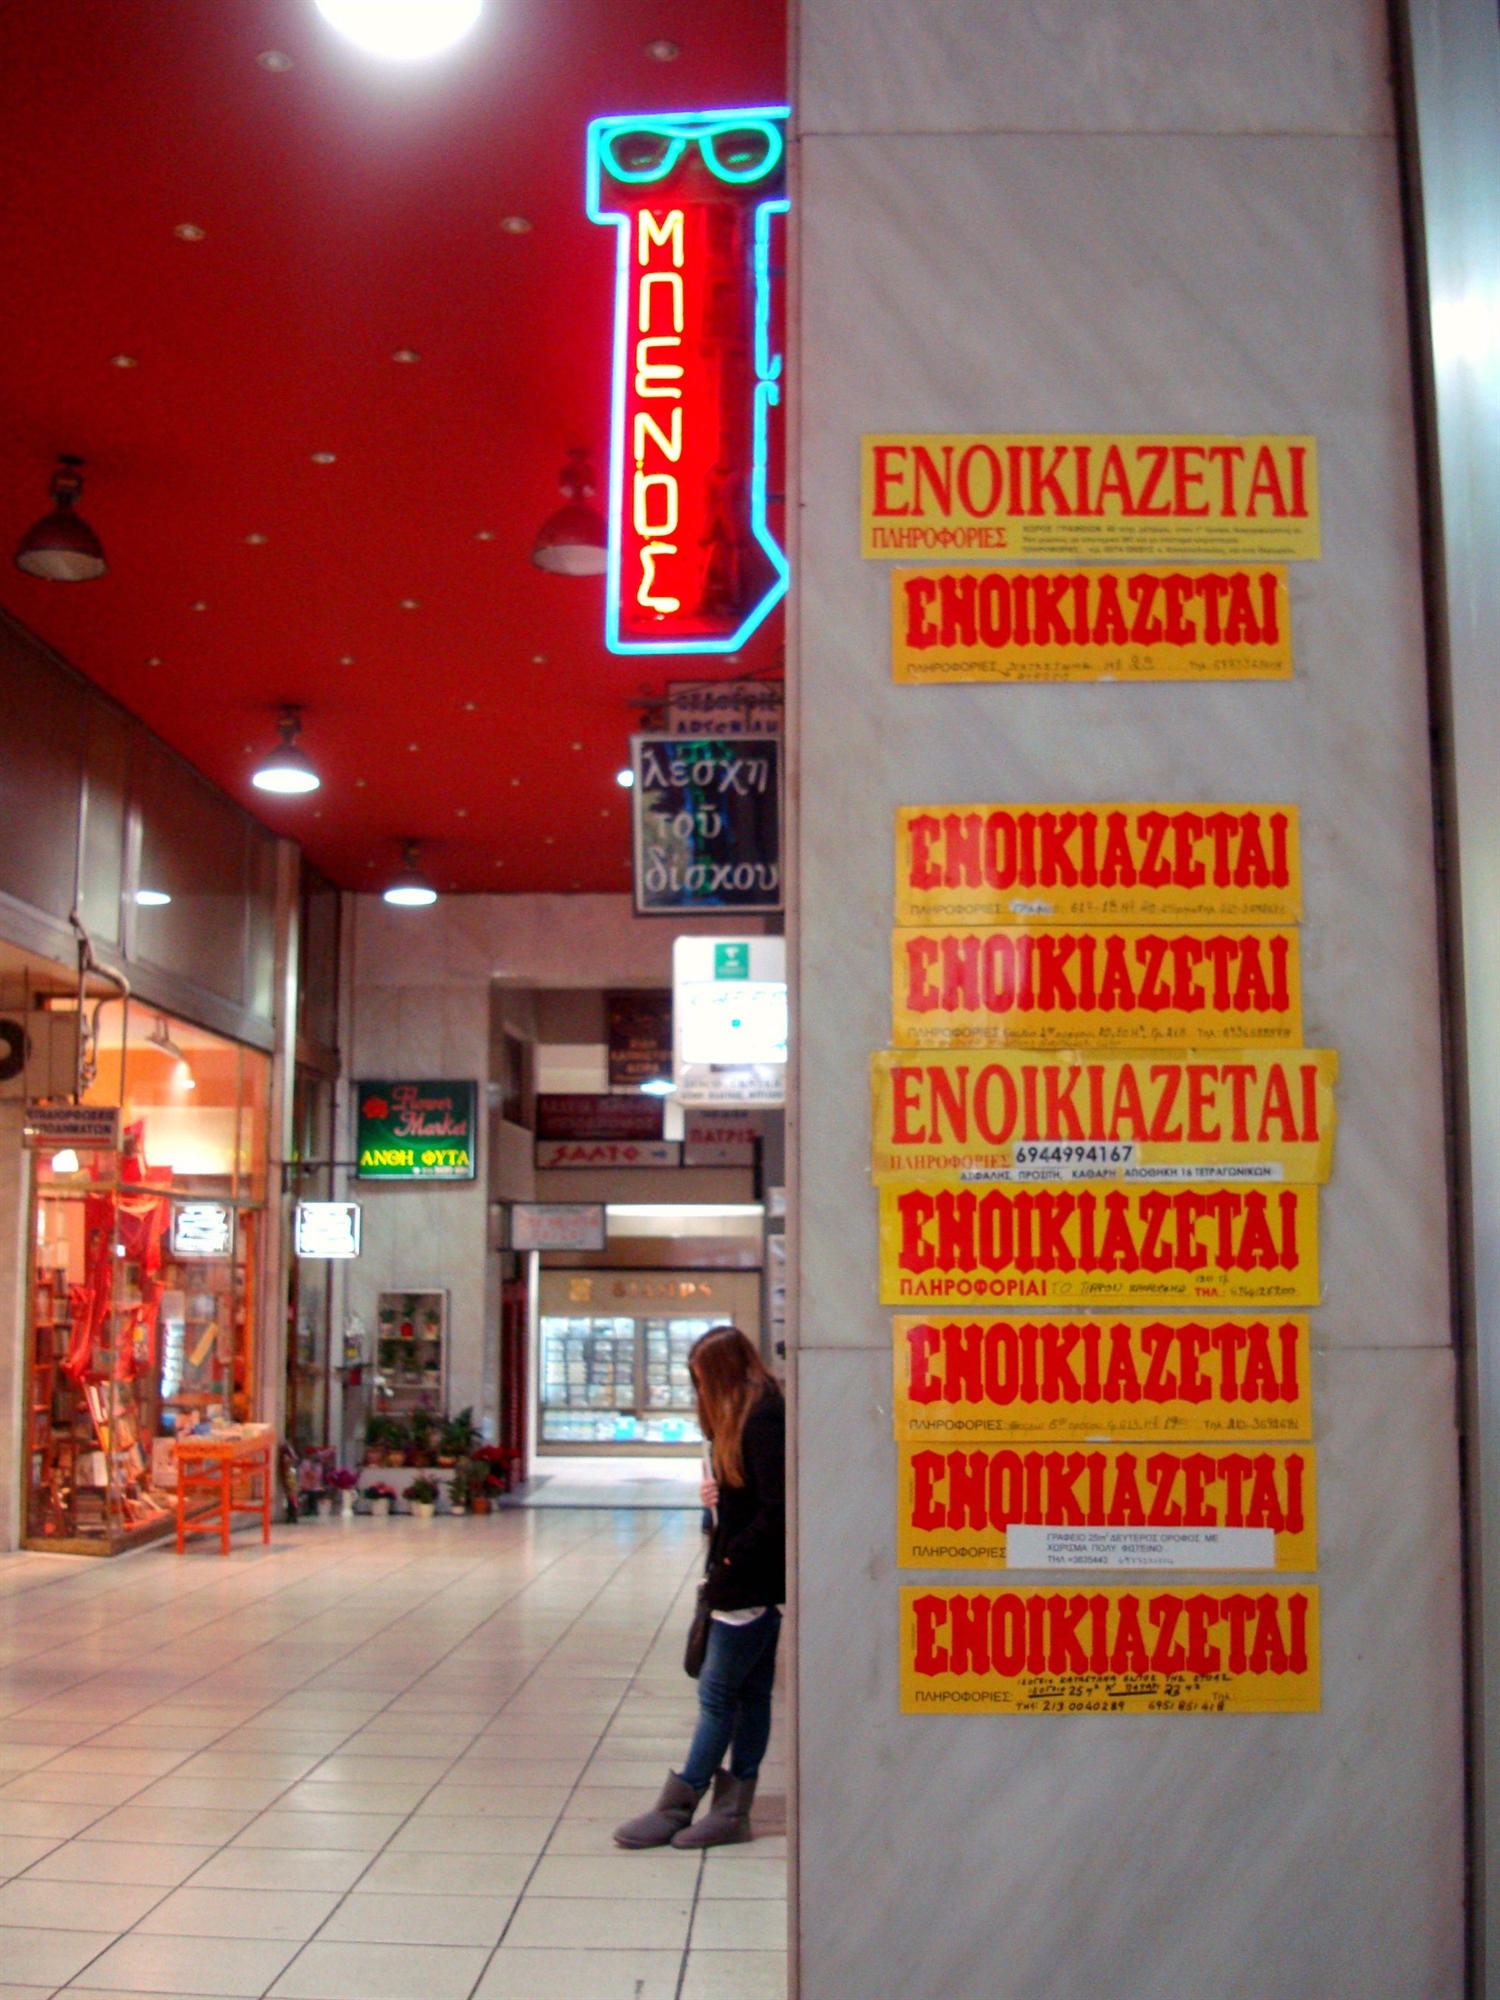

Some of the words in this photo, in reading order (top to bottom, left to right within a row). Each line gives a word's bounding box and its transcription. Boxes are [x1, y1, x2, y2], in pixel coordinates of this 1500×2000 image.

[872, 444, 1308, 518] ΕΝΟΙΚΙΑΖΕΤΑΙ
[872, 527, 1007, 549] ΠΛΗΡΟΦΟΡΙΕΣ
[904, 572, 1279, 649] ΕΝΟΙΚΙΑΖΕΤΑΙ
[907, 811, 1289, 891] ΕΝΟΙΚΙΑΖΕΤΑΙ
[906, 934, 1289, 1013] ΕΝΟΙΚΙΑΖΕΤΑΙ
[393, 1111, 467, 1137] Market
[890, 1063, 1319, 1145] ΕΝΟΙΚΙΑΖΕΤΑΙ
[361, 1149, 414, 1166] ΑΝΘΗ
[421, 1149, 469, 1166] ΦΥΤΑ
[890, 1154, 1011, 1170] ΠΛΗΡΟΦΟΡΙΕΣ
[1015, 1145, 1133, 1164] 6944994167
[1123, 1168, 1178, 1178] ΑΠΟΘΗΚΗ
[898, 1188, 1298, 1274] ΕΝΟΙΚΙΑΖΕΤΑΙ
[900, 1278, 1047, 1297] ΠΛΗΡΟΦΟΡΙΑΙ
[907, 1322, 1299, 1405] ΕΝΟΙΚΙΑΖΕΤΑΙ
[911, 1450, 1304, 1535] ΕΝΟΙΚΙΑΖΕΤΑΙ
[913, 1546, 1006, 1559] ΠΛΗΡΟΦΟΡΙΕΣ
[913, 1592, 1308, 1677] ΕΝΟΙΚΙΑΖΕΤΑΙ
